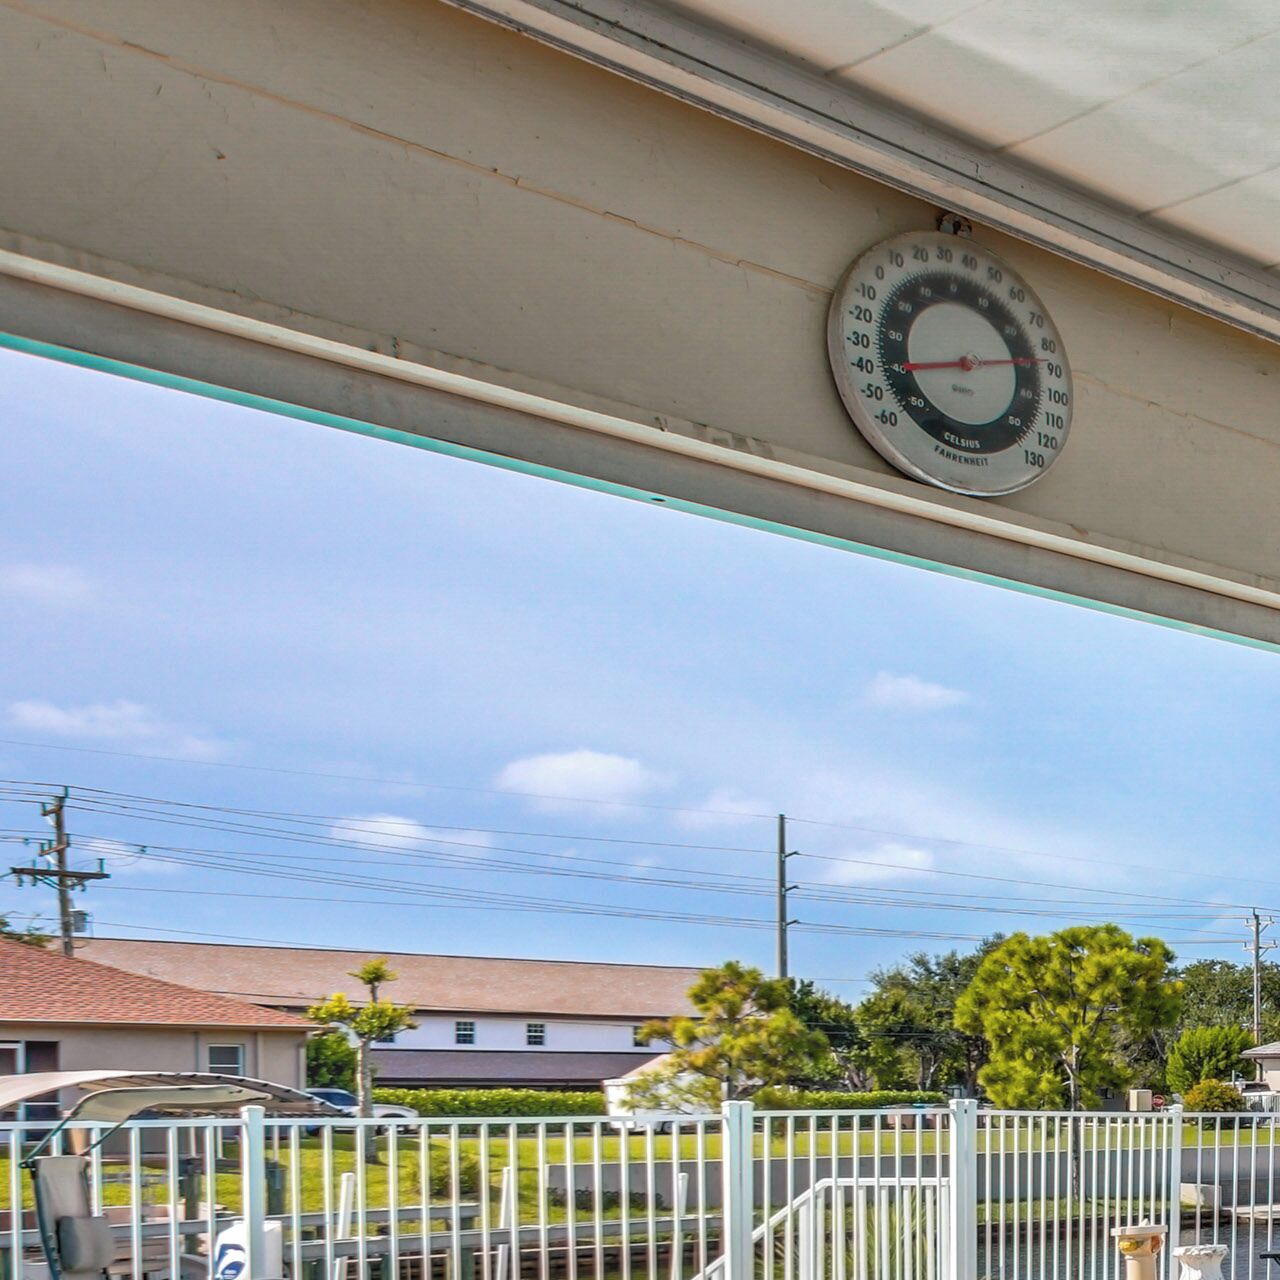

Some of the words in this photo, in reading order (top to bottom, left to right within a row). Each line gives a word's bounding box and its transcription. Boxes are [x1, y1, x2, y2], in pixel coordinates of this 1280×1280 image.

[888, 248, 904, 268] 10
[912, 245, 928, 263] 20
[937, 246, 953, 263] 30
[961, 254, 977, 271] 40
[875, 265, 885, 280] 0
[987, 266, 1002, 283] 50
[855, 282, 876, 301] -10
[921, 286, 932, 297] 10
[1009, 286, 1025, 303] 60
[898, 301, 912, 313] 20
[978, 297, 989, 308] 10
[848, 304, 873, 323] -20
[1029, 311, 1044, 328] 70
[846, 331, 870, 349] -30
[888, 330, 903, 342] 30
[1041, 337, 1056, 353] 80
[850, 356, 874, 374] -40
[1047, 362, 1062, 379] 90
[861, 383, 883, 401] -50
[1048, 387, 1069, 406] 100
[874, 409, 898, 427] -60
[1008, 415, 1021, 426] 50
[1045, 411, 1063, 430] 110
[944, 431, 981, 449] CELSIUS
[1037, 432, 1058, 450] 120
[934, 444, 988, 466] FAHRENHEIT
[1024, 449, 1044, 468] 130
